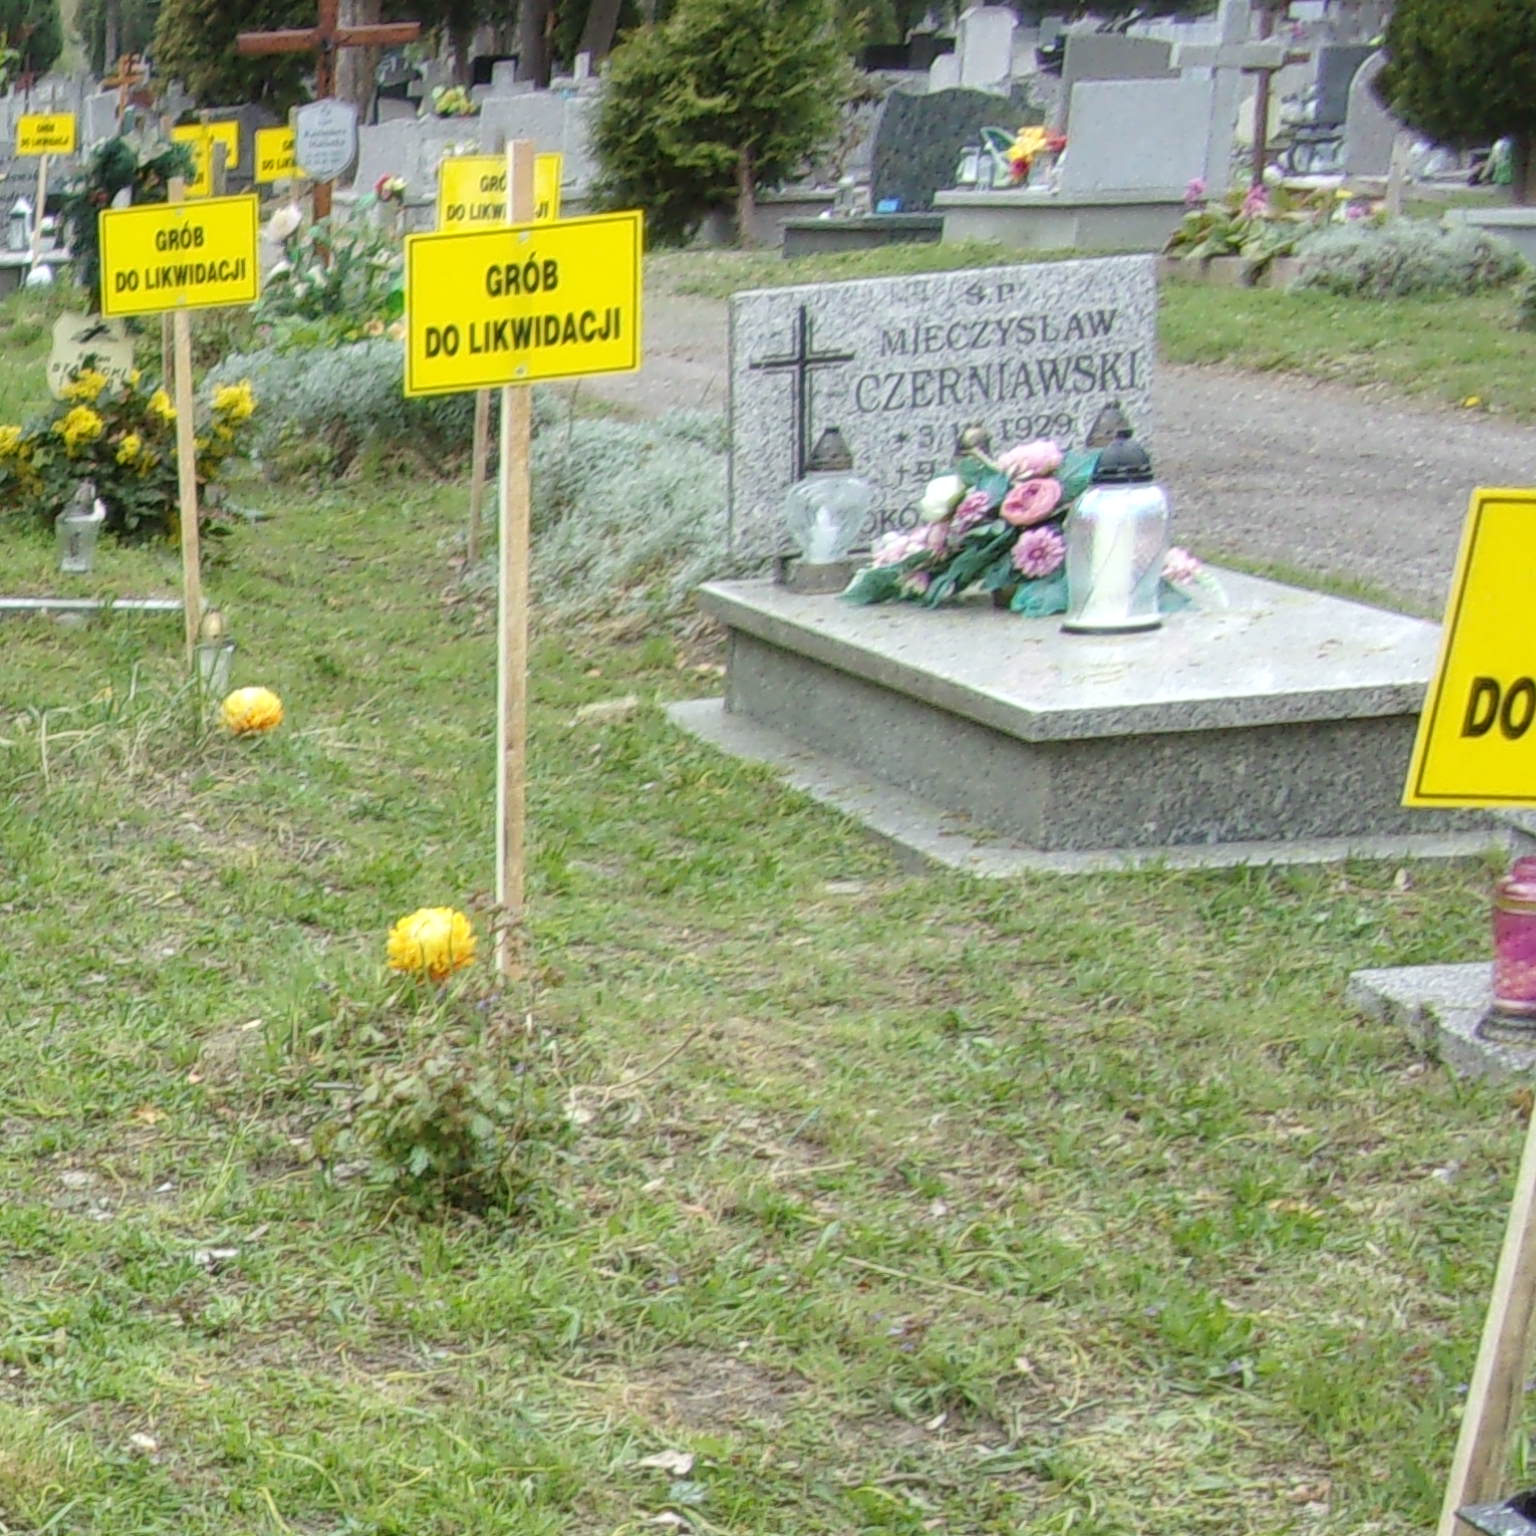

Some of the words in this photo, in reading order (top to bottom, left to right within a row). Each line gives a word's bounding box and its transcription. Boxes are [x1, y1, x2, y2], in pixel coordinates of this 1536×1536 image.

[446, 203, 466, 222] DO
[469, 200, 550, 221] LIKWJI
[155, 221, 204, 252] GRÓB
[115, 270, 140, 293] DO
[145, 258, 247, 290] LIKWIDACJI
[486, 252, 559, 297] GRÓB
[425, 324, 460, 358] DO
[469, 307, 621, 354] LIKWIDACJI
[853, 349, 1145, 414] CZERNIAWSKI
[999, 413, 1074, 442] 1929
[1461, 676, 1536, 740] DO
